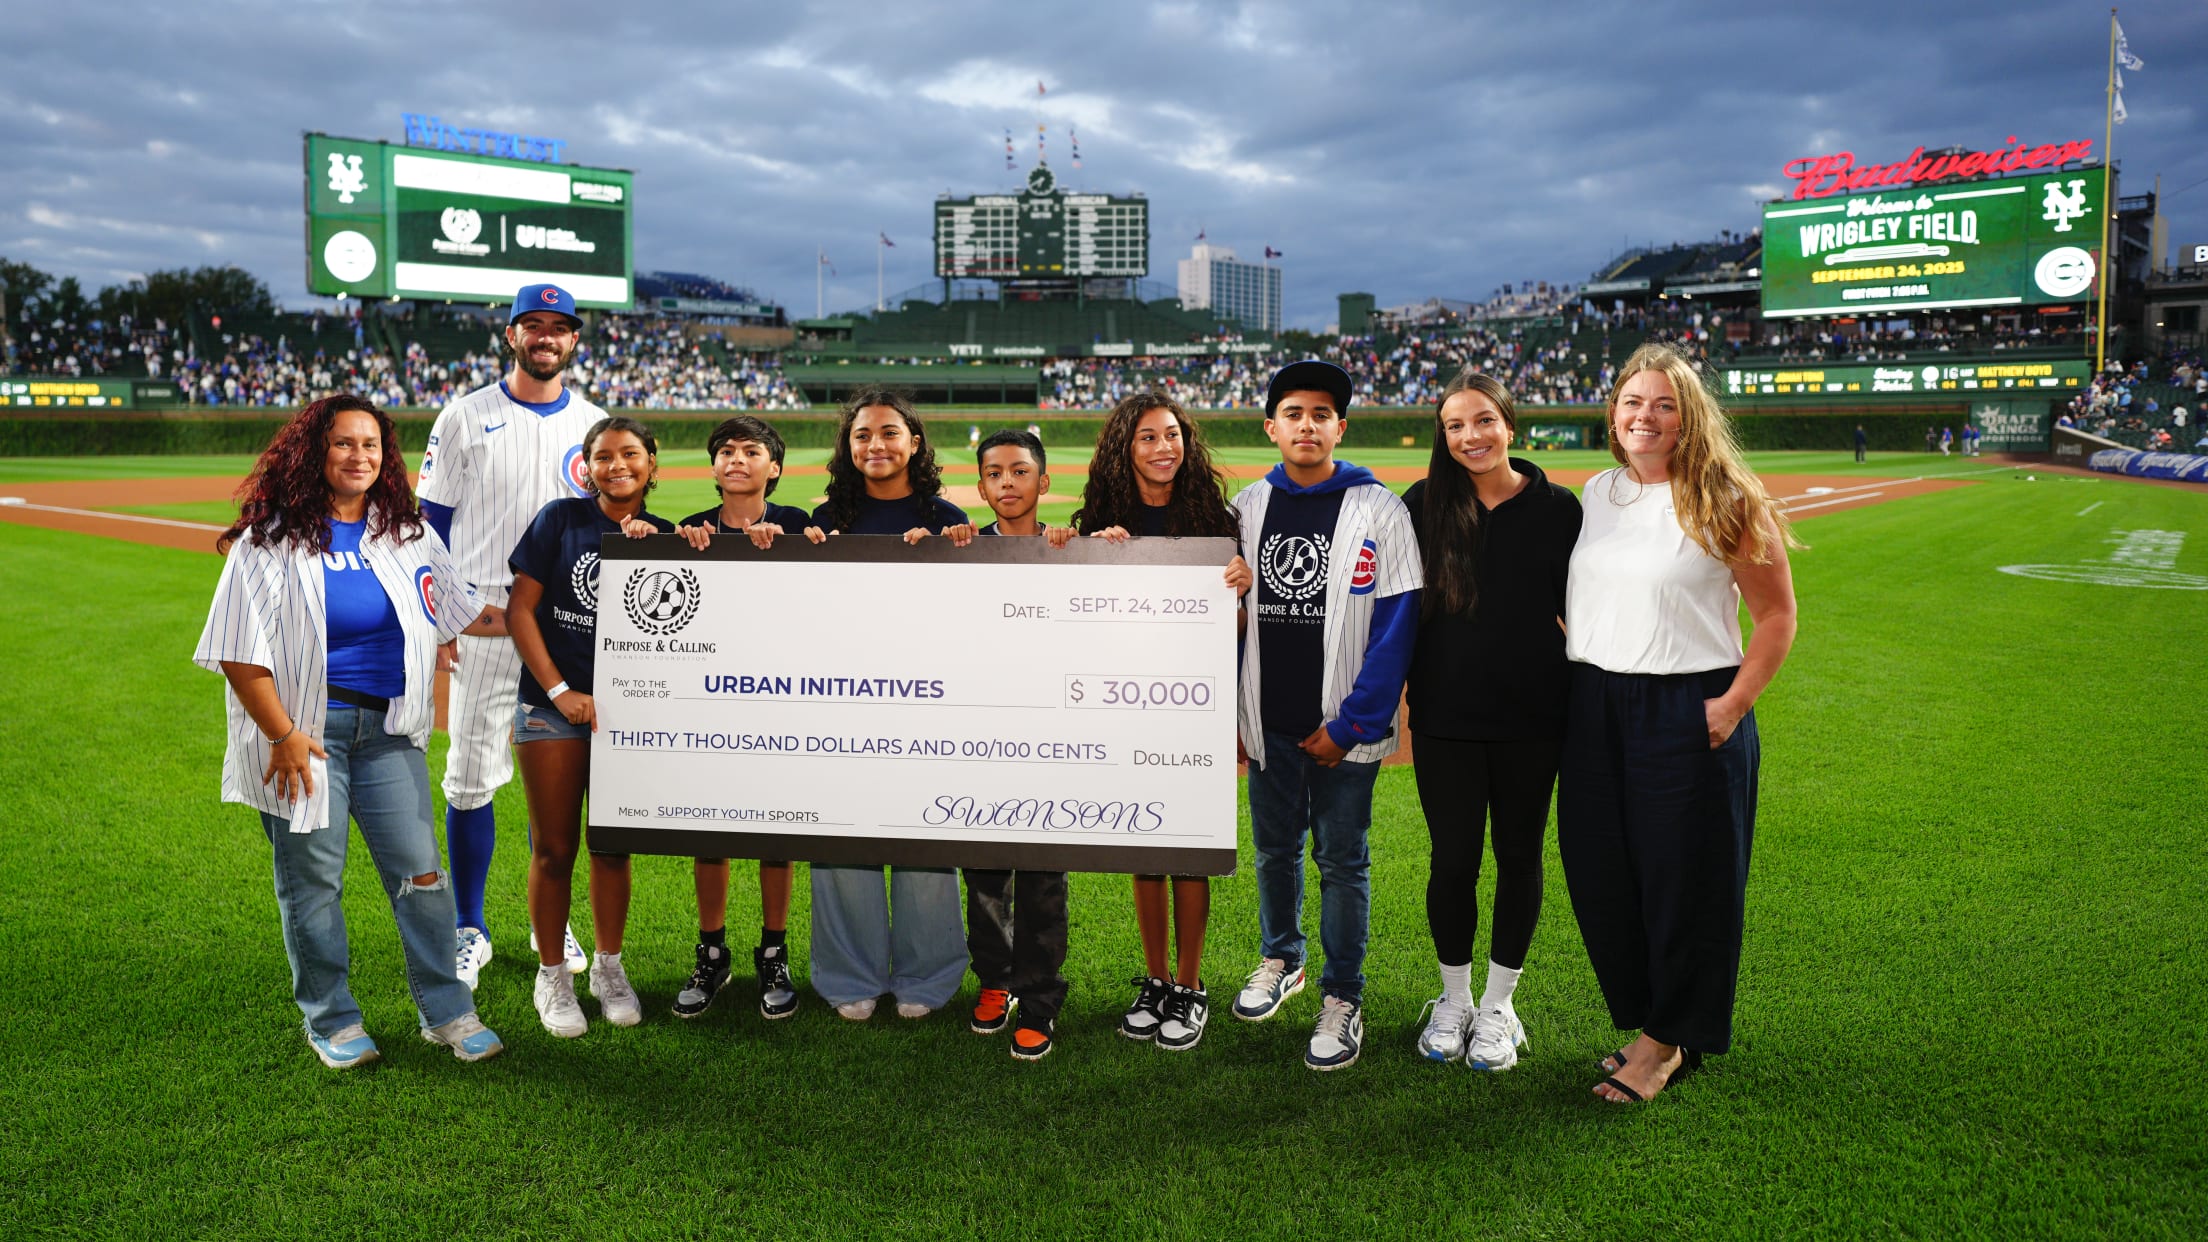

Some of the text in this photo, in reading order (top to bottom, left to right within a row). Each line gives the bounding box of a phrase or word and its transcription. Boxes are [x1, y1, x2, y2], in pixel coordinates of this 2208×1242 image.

[402, 112, 567, 163] WINTRUST
[1782, 136, 2094, 201] Budweiser
[1846, 194, 1934, 217] Welcome to
[1800, 216, 1902, 257] WRIGLEY
[1811, 266, 1895, 284] SEPTEMBER
[541, 289, 559, 304] C
[949, 344, 983, 356] YETI
[1145, 343, 1208, 356] Budweiser
[1230, 342, 1272, 353] Advocate
[1982, 414, 2041, 426] DRAFT
[1986, 424, 2039, 434] KINGS
[553, 606, 594, 627] PURPOSE
[1003, 598, 1209, 619] DATE: SEPT. 24, 2025
[1290, 603, 1300, 616] &
[558, 622, 592, 634] SWANSON
[603, 638, 716, 654] PURPOSE & CALLING
[612, 678, 667, 689] PAY TO THE
[704, 675, 945, 699] URBAN INITIATIVES
[622, 689, 671, 699] ORDER OF
[1070, 679, 1210, 709] $ 30,000
[609, 730, 1107, 760] THIRTY THOUSAND DOLLARS AND 00/100 CENTS
[1133, 749, 1213, 768] DOLLARS
[618, 806, 819, 823] MEMO SUPPORT YOUTH SPORTS
[922, 795, 1165, 833] SWANSONS
